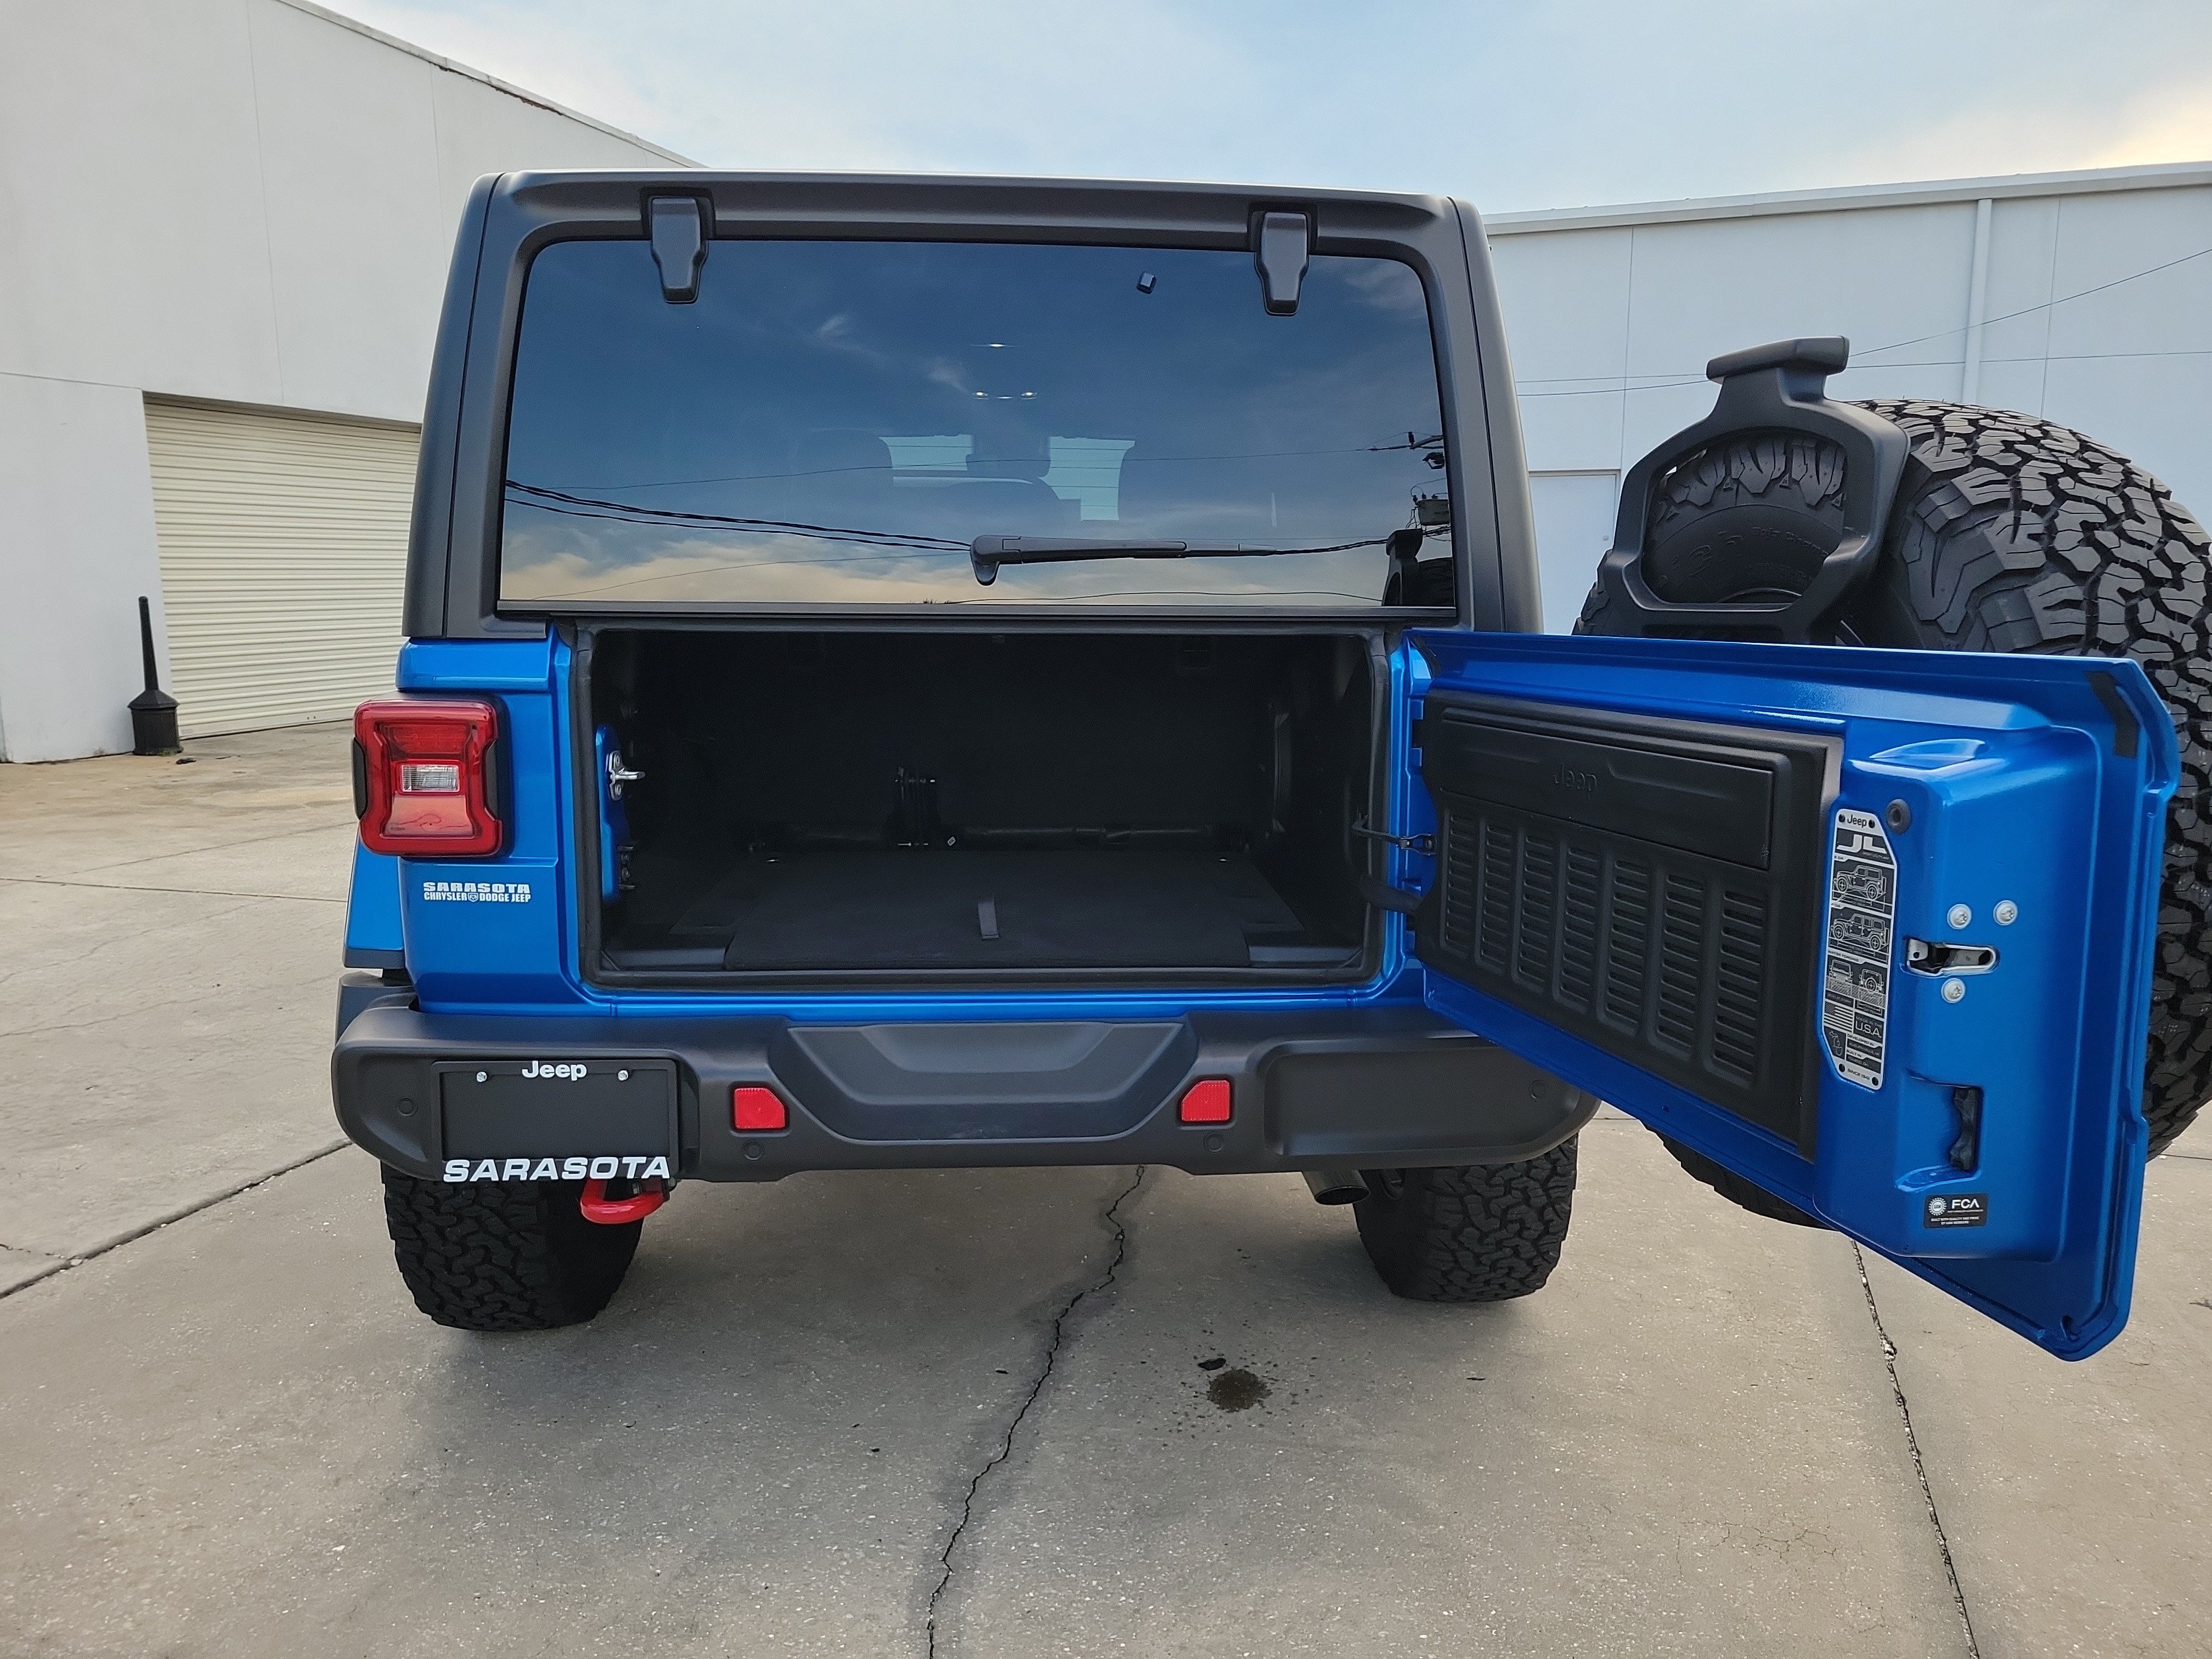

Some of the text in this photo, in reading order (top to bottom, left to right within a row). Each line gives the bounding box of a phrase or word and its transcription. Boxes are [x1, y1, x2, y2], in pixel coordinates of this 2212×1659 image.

[1847, 815, 1867, 828] Jeep
[1836, 834, 1887, 854] JL
[423, 882, 531, 894] SARASOTA
[424, 892, 531, 902] CHRYSLER DODGE JEEP
[1855, 1020, 1882, 1038] U.S.A.
[522, 1060, 587, 1081] Jeep
[443, 1156, 670, 1182] SARASOTA
[1951, 1198, 1980, 1209] FCA
